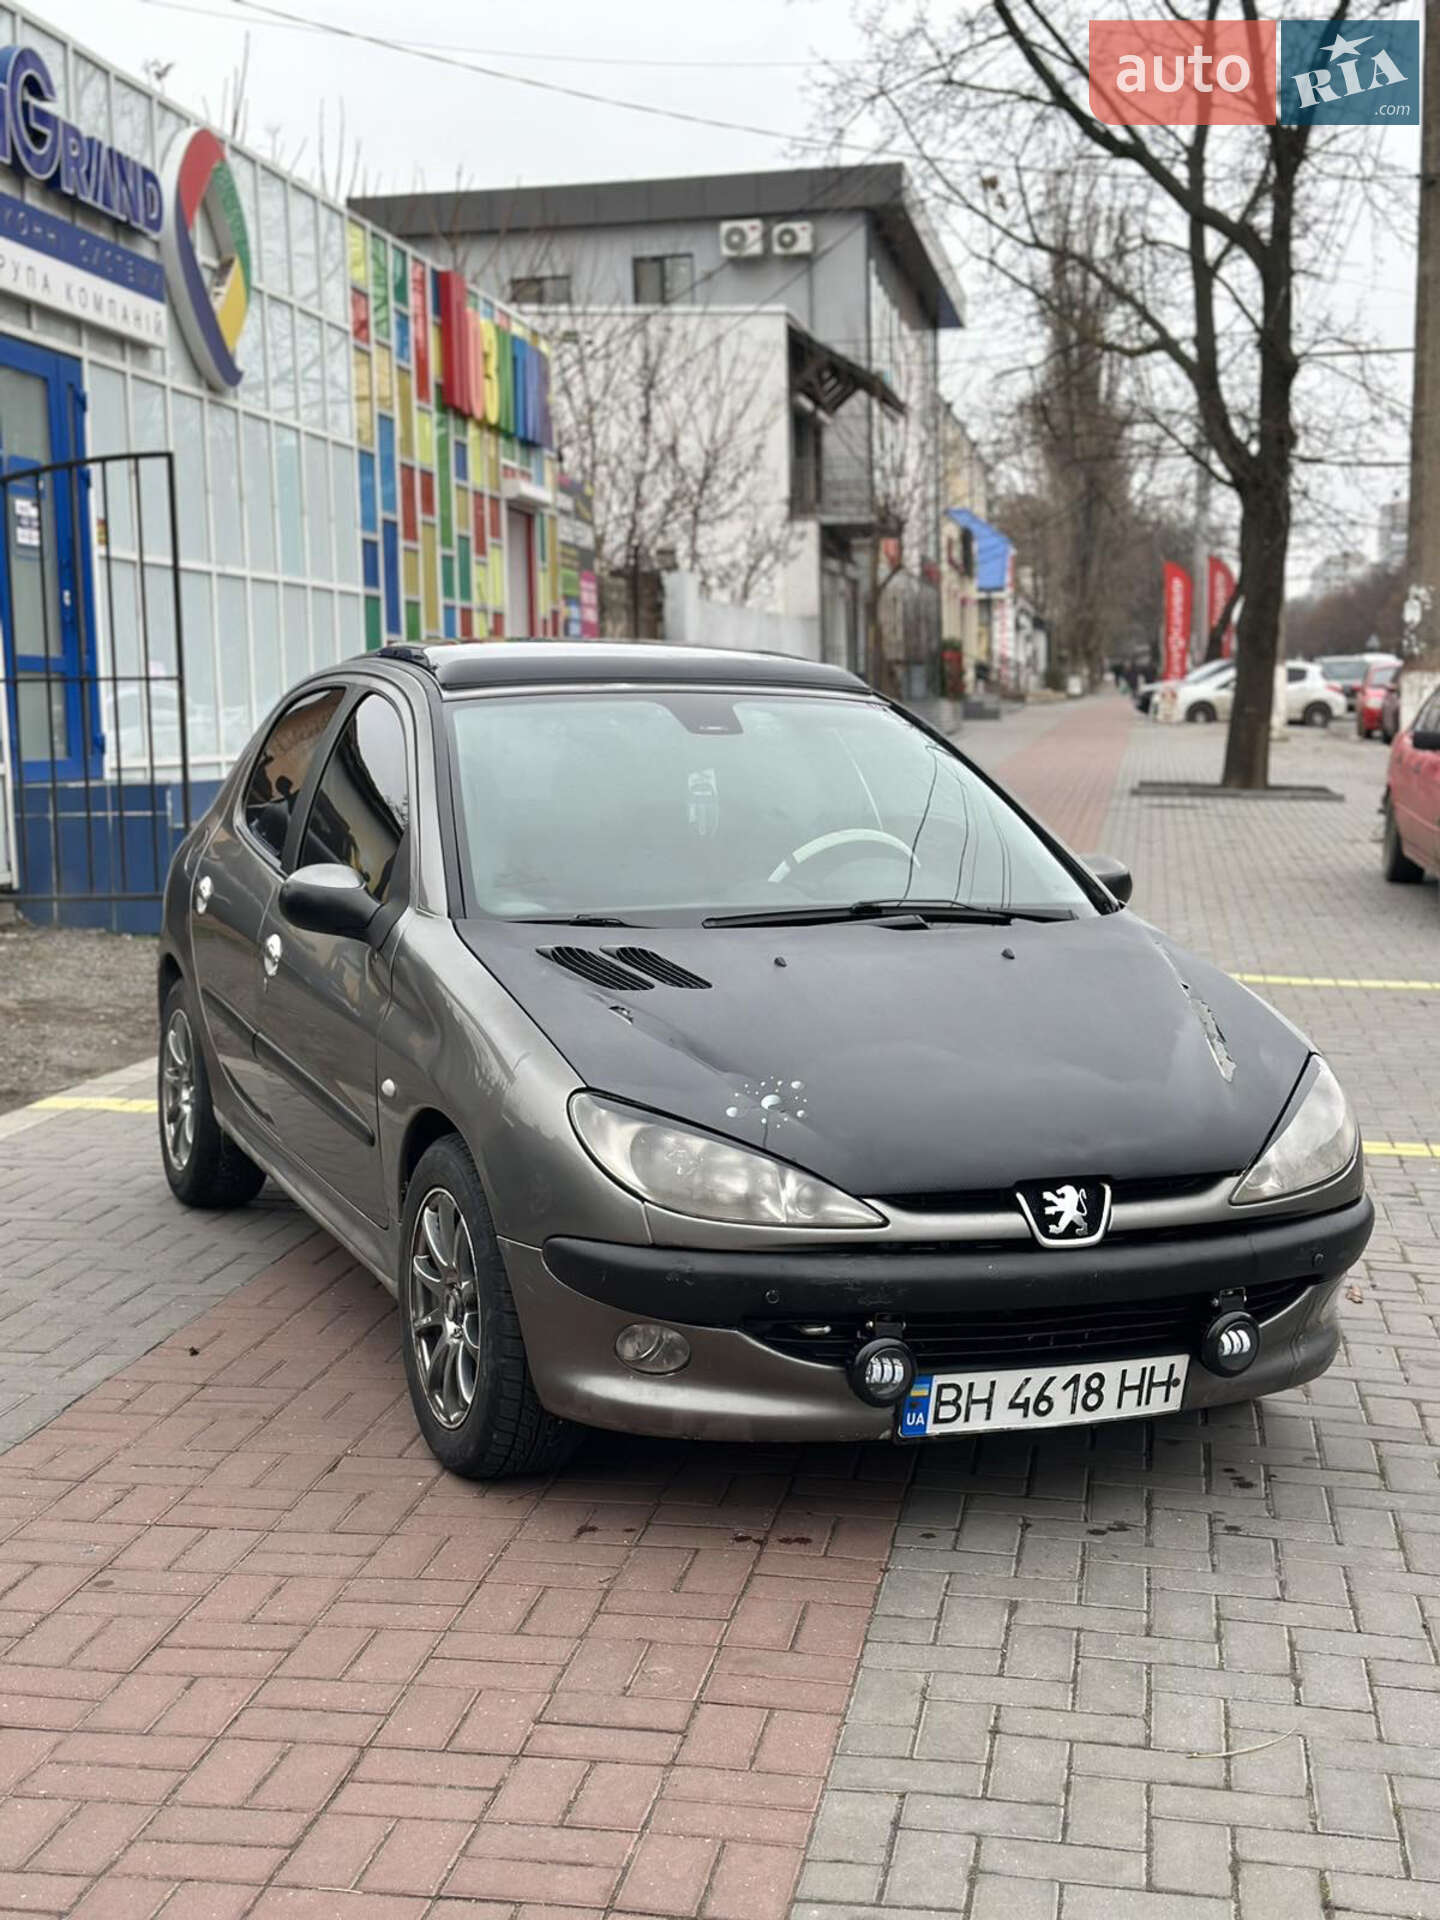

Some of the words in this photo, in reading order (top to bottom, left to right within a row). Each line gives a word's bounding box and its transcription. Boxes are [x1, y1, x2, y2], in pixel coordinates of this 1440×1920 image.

[0, 46, 164, 240] GRAND
[65, 282, 164, 336] КОМПАНІЙ
[905, 1411, 926, 1427] UA
[932, 1380, 997, 1426] BH
[1008, 1371, 1107, 1419] 4618
[1117, 1363, 1176, 1410] HH
